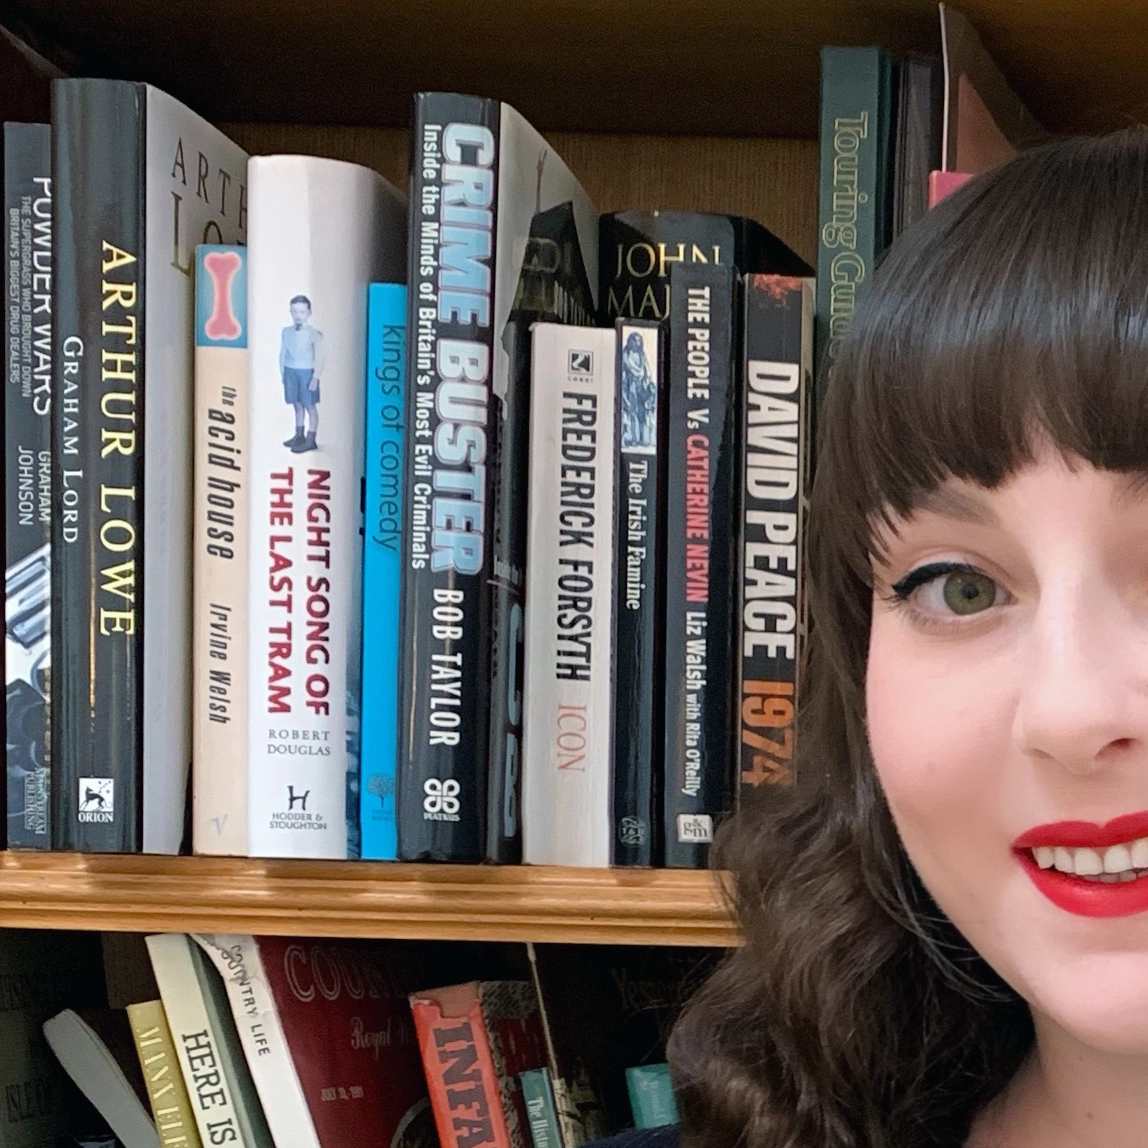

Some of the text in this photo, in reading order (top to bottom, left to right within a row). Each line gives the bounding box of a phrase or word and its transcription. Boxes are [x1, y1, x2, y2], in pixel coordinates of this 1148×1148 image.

[21, 196, 31, 216] THE
[823, 112, 868, 250] Touring
[21, 218, 31, 286] SUPERGRASS
[21, 365, 31, 398] DOWN
[412, 124, 442, 570] Inside the Minds of Britain's Most Evil Criminals
[430, 122, 496, 576] CRIME BUSTER
[18, 445, 34, 526] JOHNSON
[38, 450, 52, 523] GRAHAM
[62, 336, 84, 543] GRAHAM LORD
[100, 240, 138, 636] ARTHUR LOWE
[206, 386, 242, 561] the acid house
[371, 324, 406, 551] kings of comedy
[557, 391, 598, 547] FREDERICK
[685, 286, 711, 602] THE PEOPLE Vs CATHERINE NEVIN
[267, 467, 294, 713] THE LAST TRAM
[305, 469, 332, 716] NIGHT SONG OF
[625, 460, 649, 610] The Irish Famine
[741, 359, 800, 788] DAVID PEACE 1974
[209, 603, 232, 725] Irvine Welsh
[429, 588, 465, 747] BOB TAYLOR
[554, 558, 594, 682] FORSYTH
[267, 744, 331, 757] DOUGLAS
[268, 729, 331, 742] ROBERT
[556, 704, 587, 773] ICON
[681, 612, 708, 797] Liz Walsh with Rita O'Reilly
[78, 811, 115, 823] ORION
[269, 821, 327, 830] STOUGHTON
[272, 812, 323, 821] HODDER &
[136, 1026, 176, 1100] MANX
[182, 1028, 228, 1110] HERE
[206, 1118, 238, 1146] IS
[251, 1023, 271, 1057] LIFE
